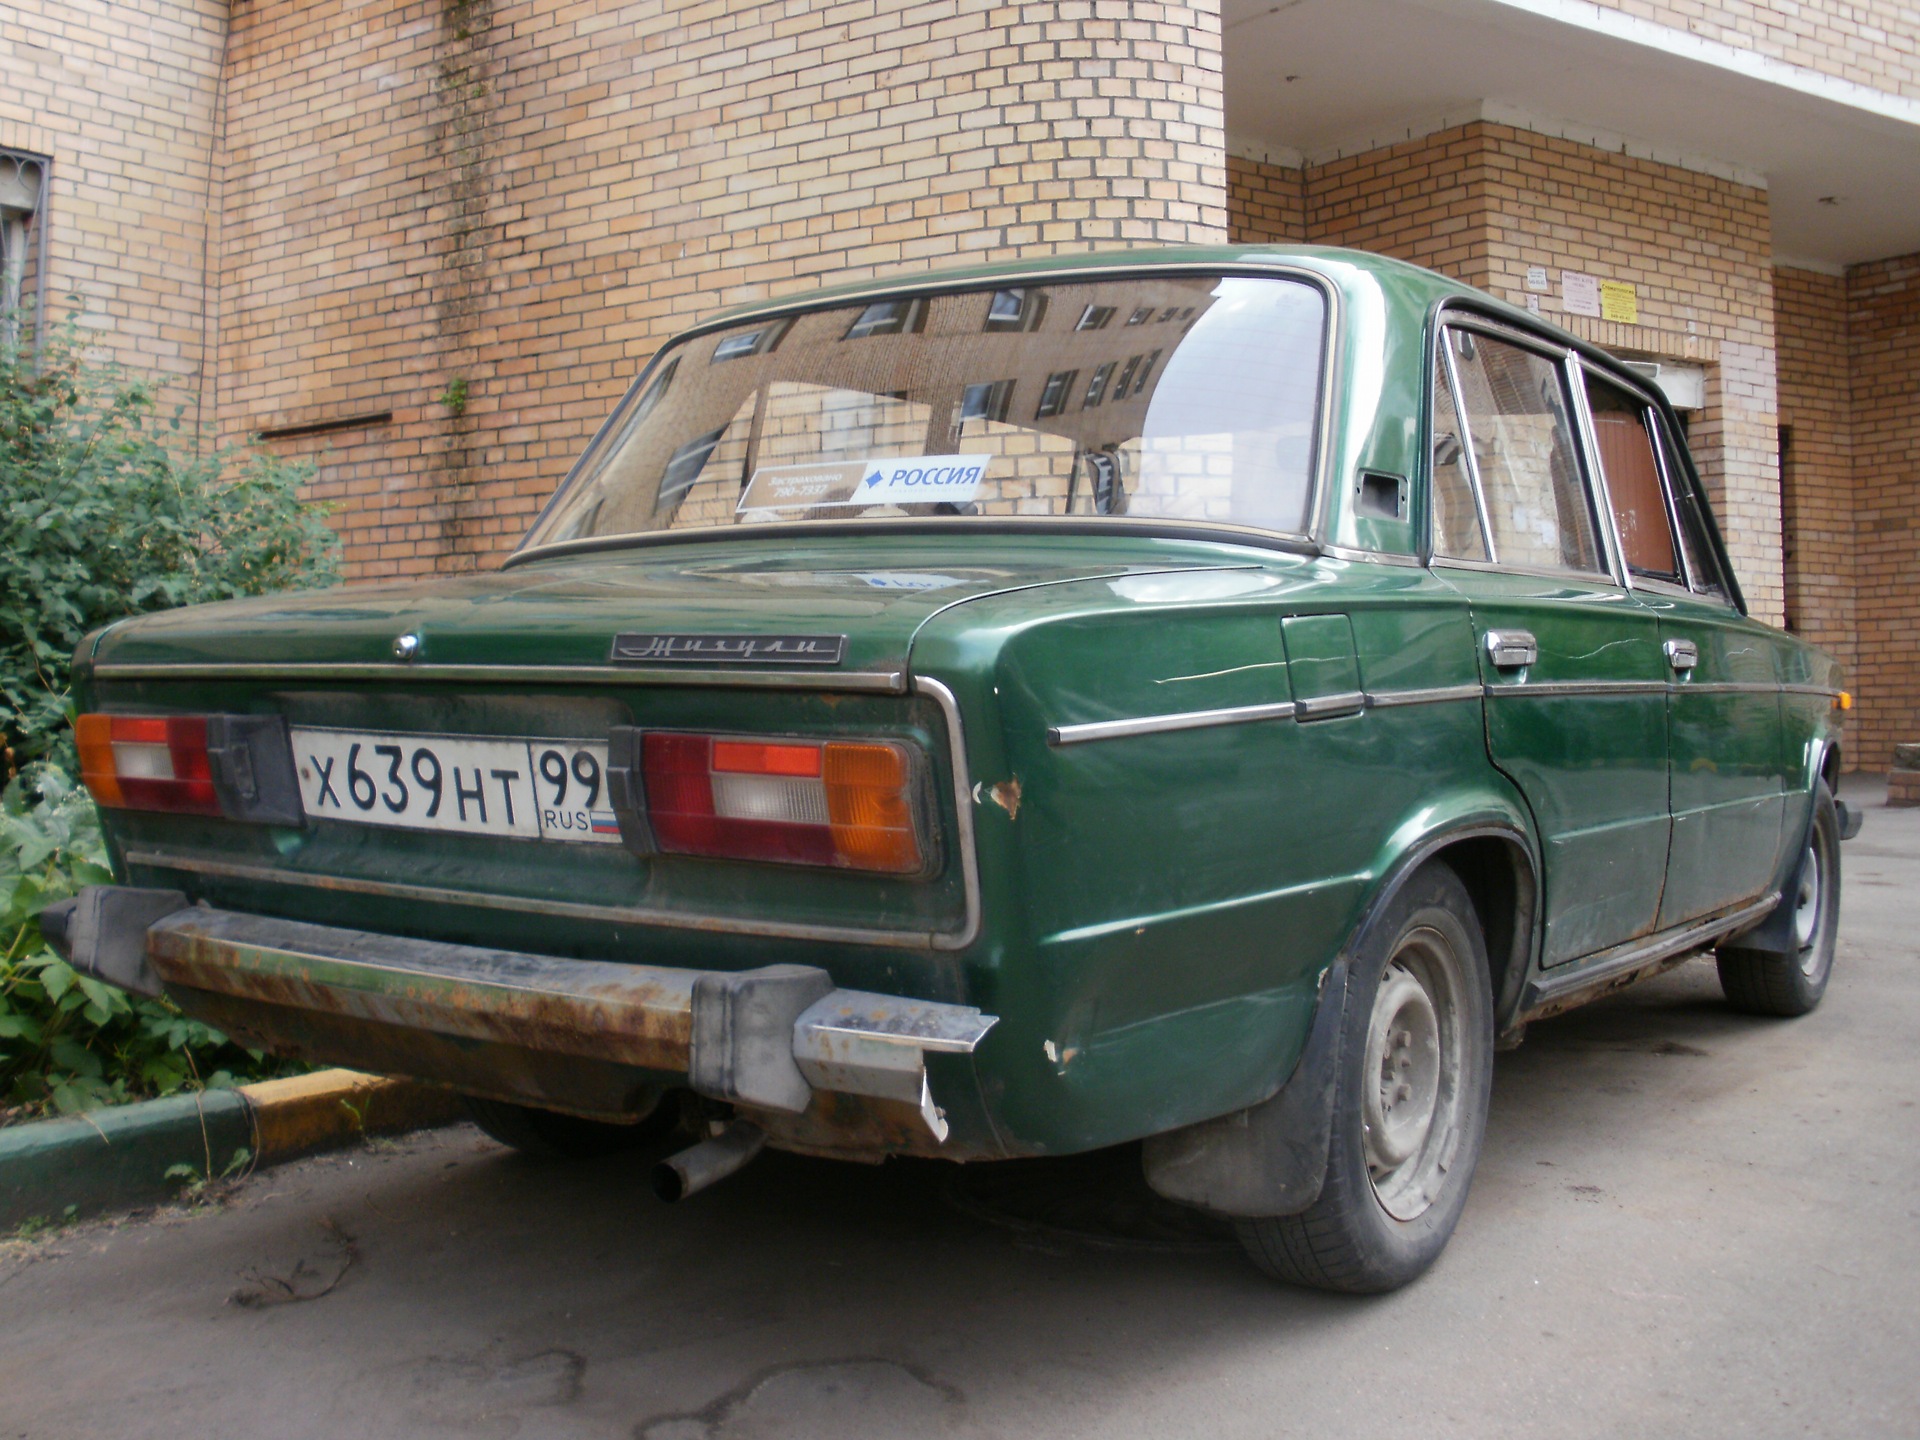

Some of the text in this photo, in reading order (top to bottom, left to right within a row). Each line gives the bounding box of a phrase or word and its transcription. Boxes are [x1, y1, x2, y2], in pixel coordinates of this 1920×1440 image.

[889, 466, 981, 487] РОССИЯ
[619, 637, 836, 658] Жигули
[309, 743, 520, 826] Х639НТ
[539, 749, 601, 808] 99
[544, 809, 589, 831] RUS
